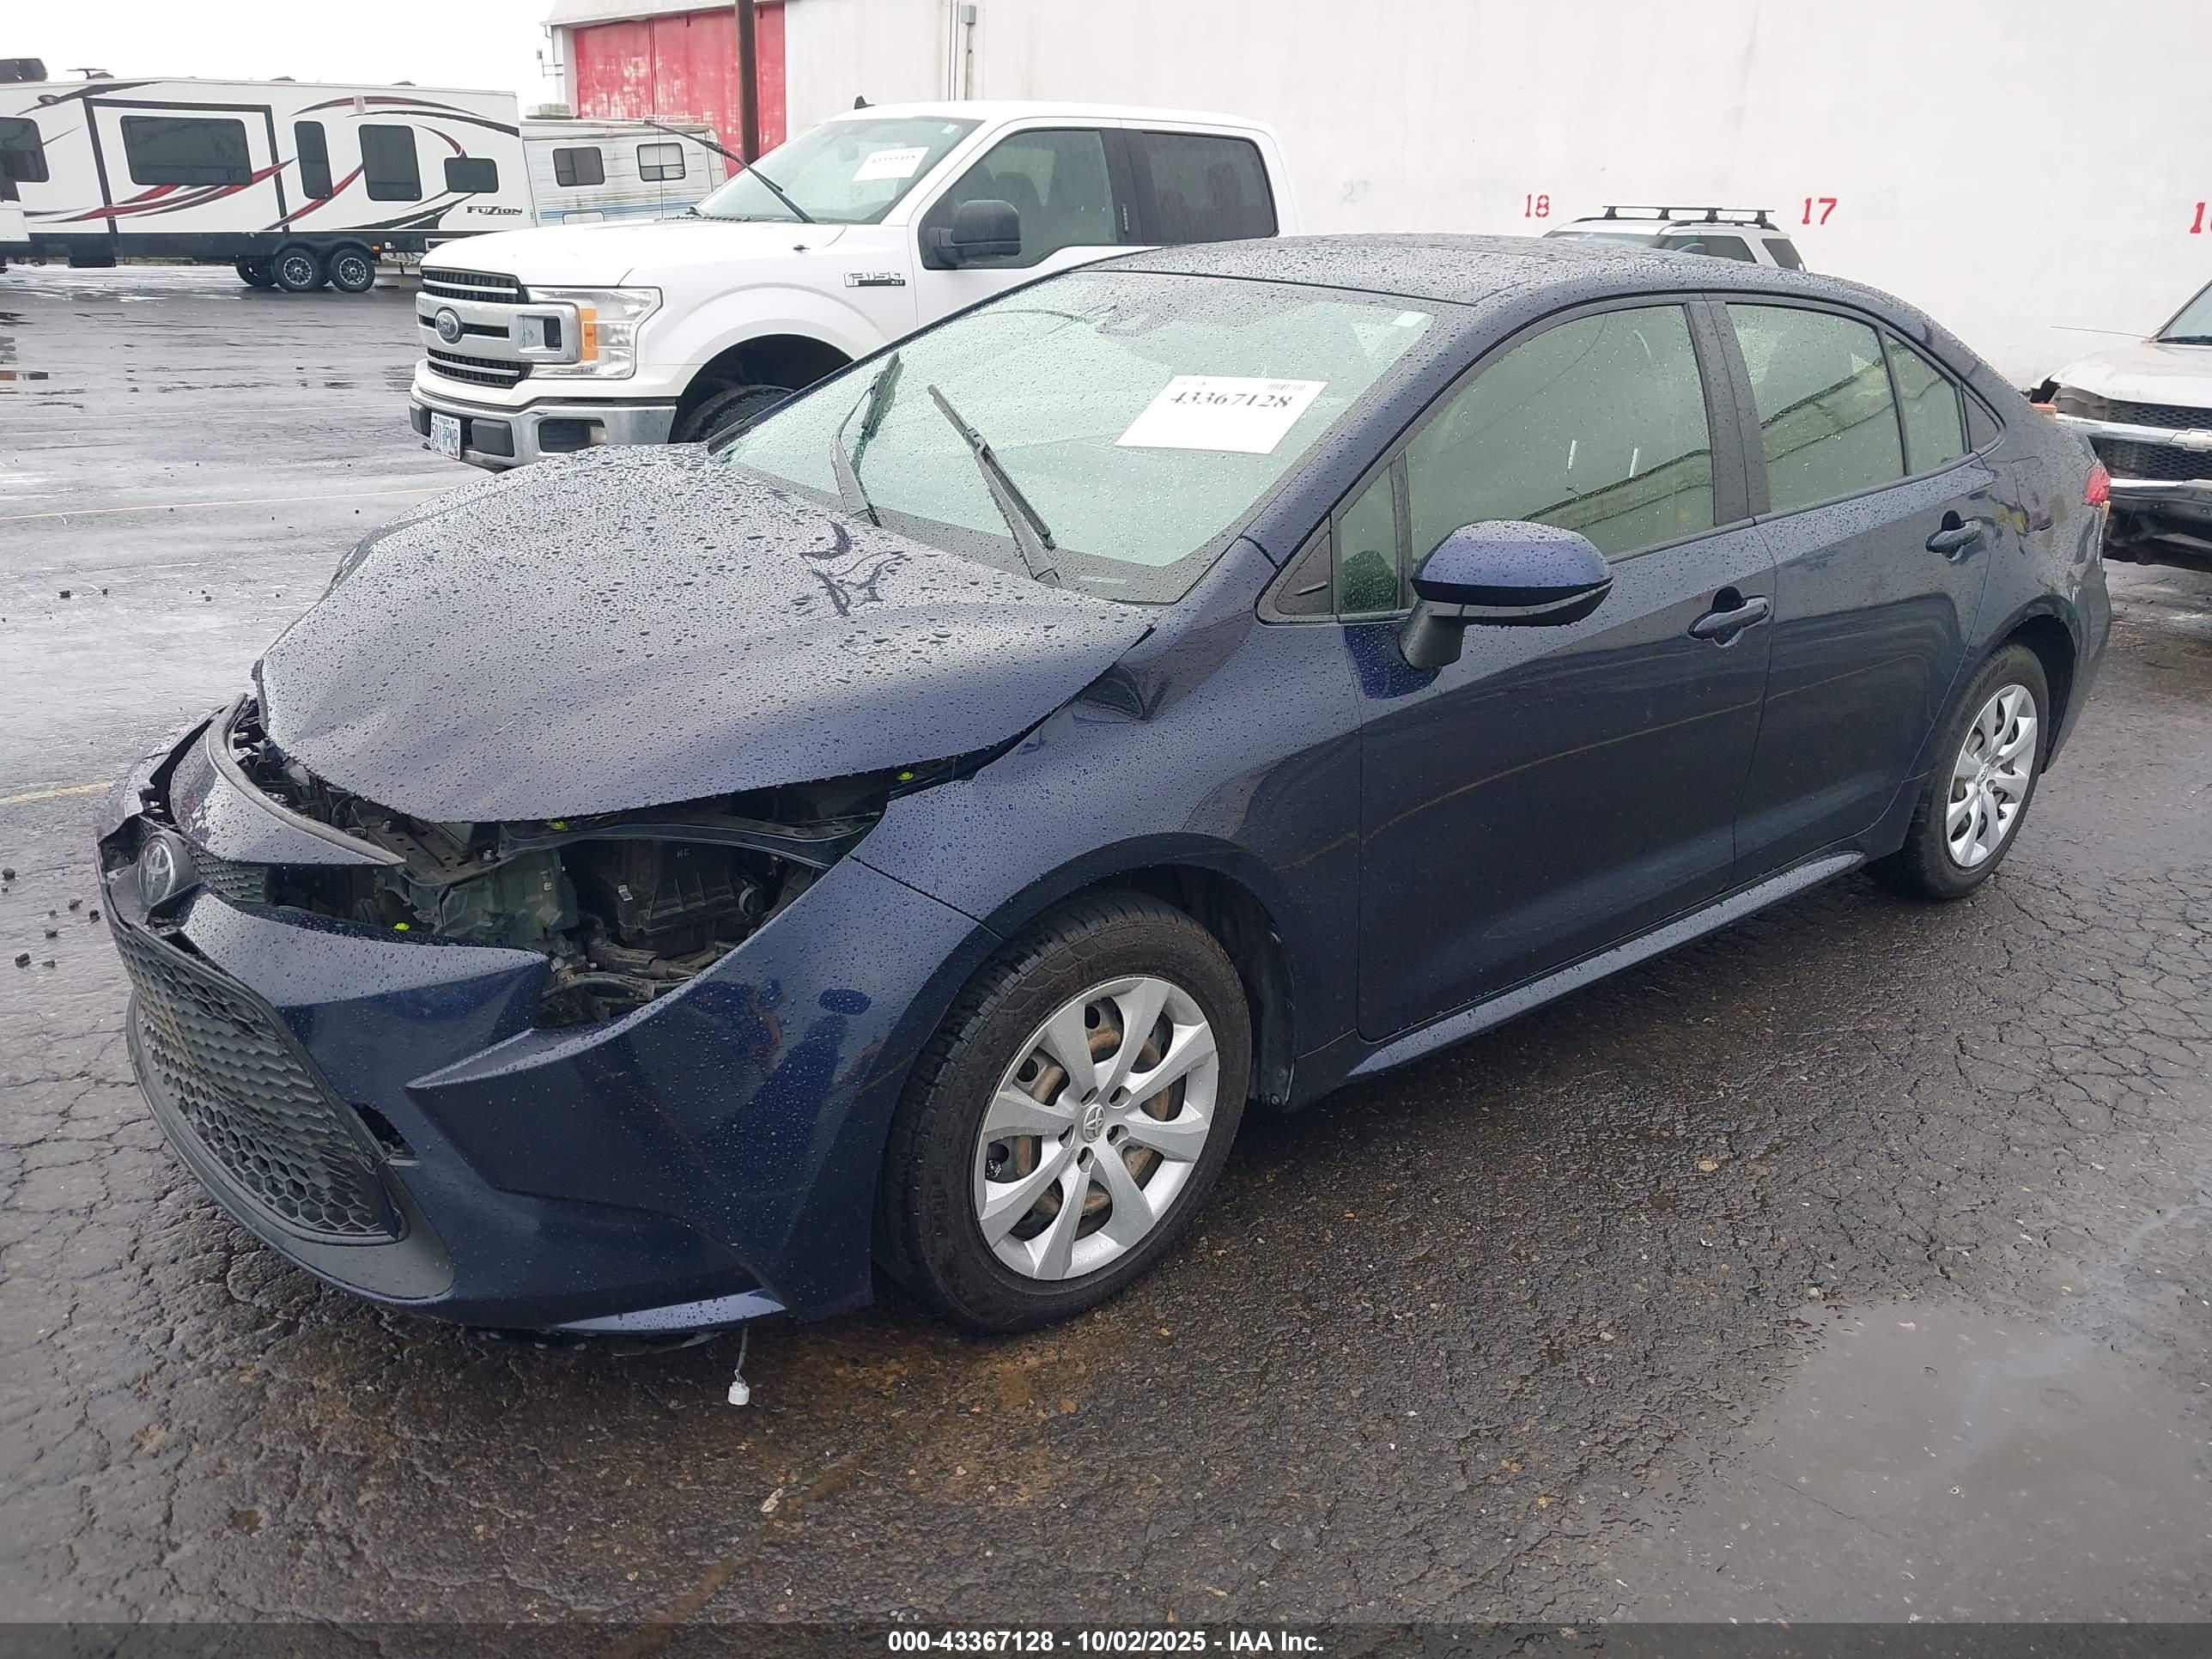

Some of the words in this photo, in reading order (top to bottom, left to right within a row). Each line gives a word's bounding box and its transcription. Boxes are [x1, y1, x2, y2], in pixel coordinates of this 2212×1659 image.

[1525, 194, 1549, 217] 18
[1802, 198, 1837, 225] 17
[2191, 202, 2212, 234] 1
[1170, 392, 1293, 408] 43367128
[431, 422, 441, 446] 501
